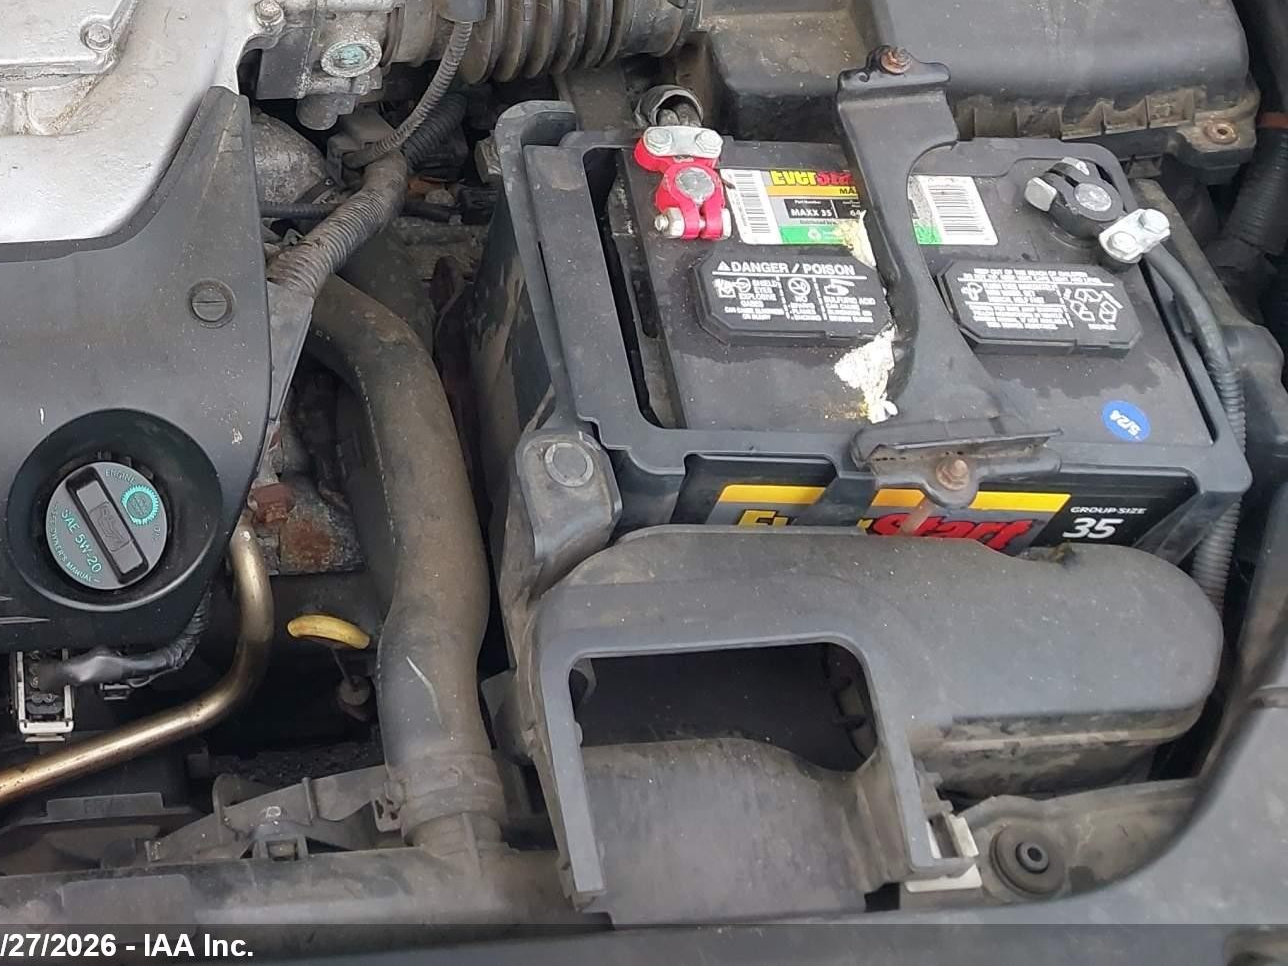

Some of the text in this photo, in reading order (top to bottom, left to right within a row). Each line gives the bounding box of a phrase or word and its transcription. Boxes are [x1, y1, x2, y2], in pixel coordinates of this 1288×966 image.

[790, 208, 833, 217] MAXX 35
[731, 261, 856, 276] DANGER / POISON
[1070, 506, 1148, 515] GROUP SIZE
[1061, 517, 1124, 539] 35
[61, 509, 102, 573] SAE 5W-20
